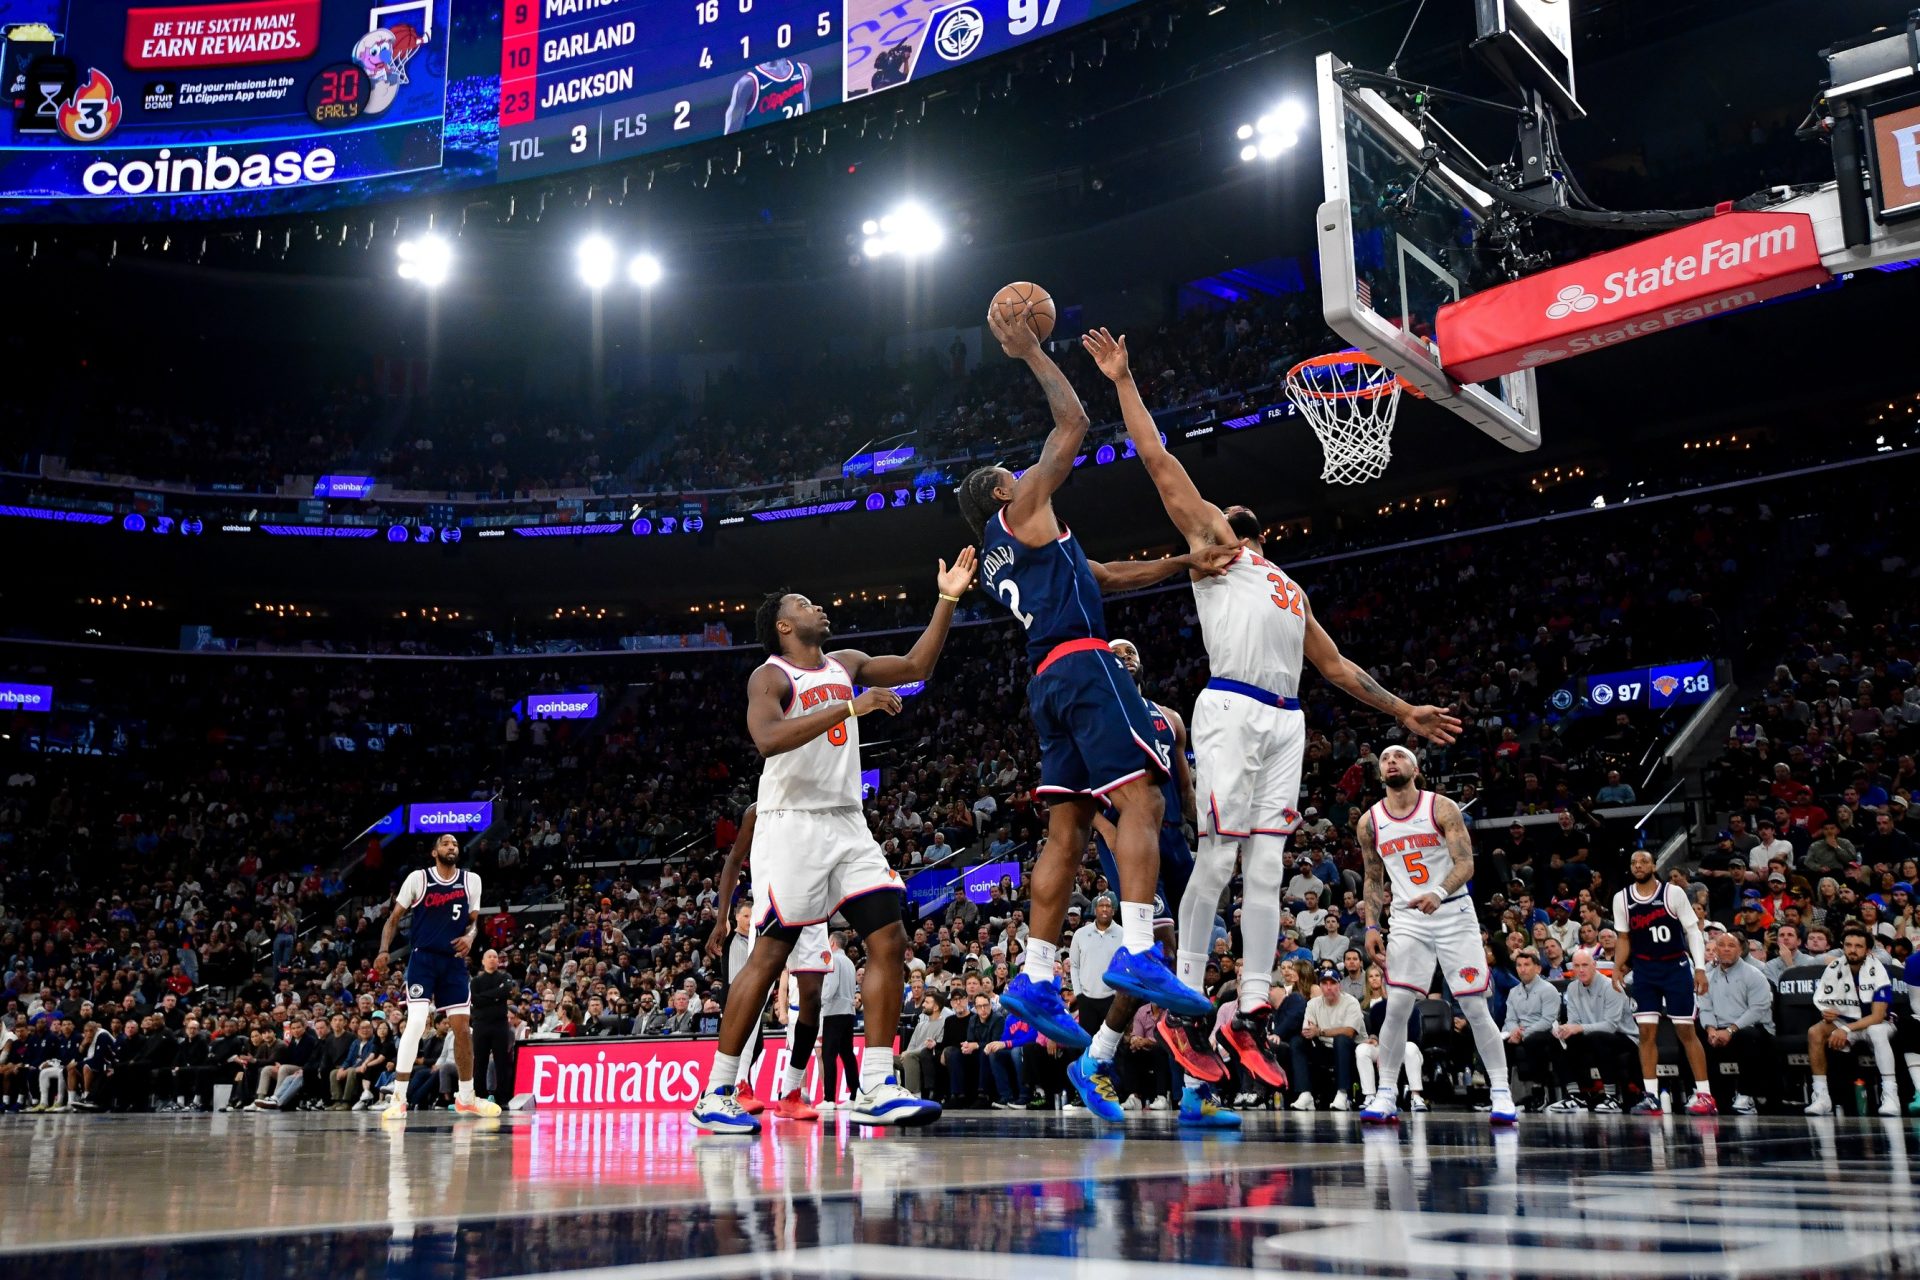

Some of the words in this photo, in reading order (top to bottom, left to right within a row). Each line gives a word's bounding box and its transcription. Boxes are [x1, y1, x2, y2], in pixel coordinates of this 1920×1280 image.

[153, 22, 172, 36] BE
[176, 20, 205, 36] THE
[207, 18, 251, 34] SIXTH
[254, 13, 296, 30] MAN!
[516, 4, 528, 24] 9
[696, 0, 719, 25] 16
[142, 38, 197, 58] EARN
[200, 30, 301, 55] REWARDS.
[508, 48, 530, 68] 10
[543, 22, 636, 62] GARLAND
[700, 48, 713, 69] 4
[740, 36, 750, 58] 1
[777, 24, 792, 48] 0
[817, 12, 831, 36] 5
[179, 94, 194, 104] LA
[195, 92, 234, 106] Clippers
[234, 91, 254, 102] App
[256, 87, 286, 100] today!
[180, 82, 202, 94] Find
[202, 84, 224, 96] your
[225, 79, 267, 91] missions
[268, 78, 278, 87] in
[278, 76, 294, 86] the
[320, 70, 358, 104] 30
[504, 92, 530, 114] 23
[541, 67, 634, 108] JACKSON
[74, 98, 108, 138] 3
[316, 103, 358, 120] EARLY
[510, 137, 544, 162] TOL
[570, 124, 587, 154] 3
[614, 113, 647, 141] FLS
[673, 100, 690, 130] 2
[82, 146, 336, 194] coinbase
[1268, 409, 1282, 418] FLS:
[1288, 404, 1296, 416] 2
[1186, 426, 1214, 438] coinbase
[720, 517, 744, 525] coinbase
[772, 507, 807, 518] FUTURE
[808, 506, 818, 516] IS
[818, 500, 856, 513] CRYPTO
[222, 524, 250, 532] coinbase
[282, 526, 324, 536] FUTURE
[324, 528, 335, 536] IS
[335, 528, 378, 538] CRYPTO
[534, 526, 572, 536] FUTURE
[572, 526, 583, 534] IS
[583, 524, 624, 534] CRYPTO
[998, 579, 1034, 630] 2
[1266, 572, 1304, 620] 32
[799, 686, 828, 712] NEW
[1618, 683, 1641, 702] 97
[536, 700, 588, 712] coinbase
[420, 810, 482, 825] coinbase
[1380, 838, 1406, 858] NEW
[1404, 834, 1442, 848] YORK
[1402, 851, 1430, 885] 5
[424, 889, 464, 908] Clippers
[452, 904, 462, 920] 5
[1648, 925, 1671, 943] 10
[1780, 980, 1796, 994] GET
[1796, 980, 1814, 994] THE
[532, 1051, 700, 1104] Emirates
